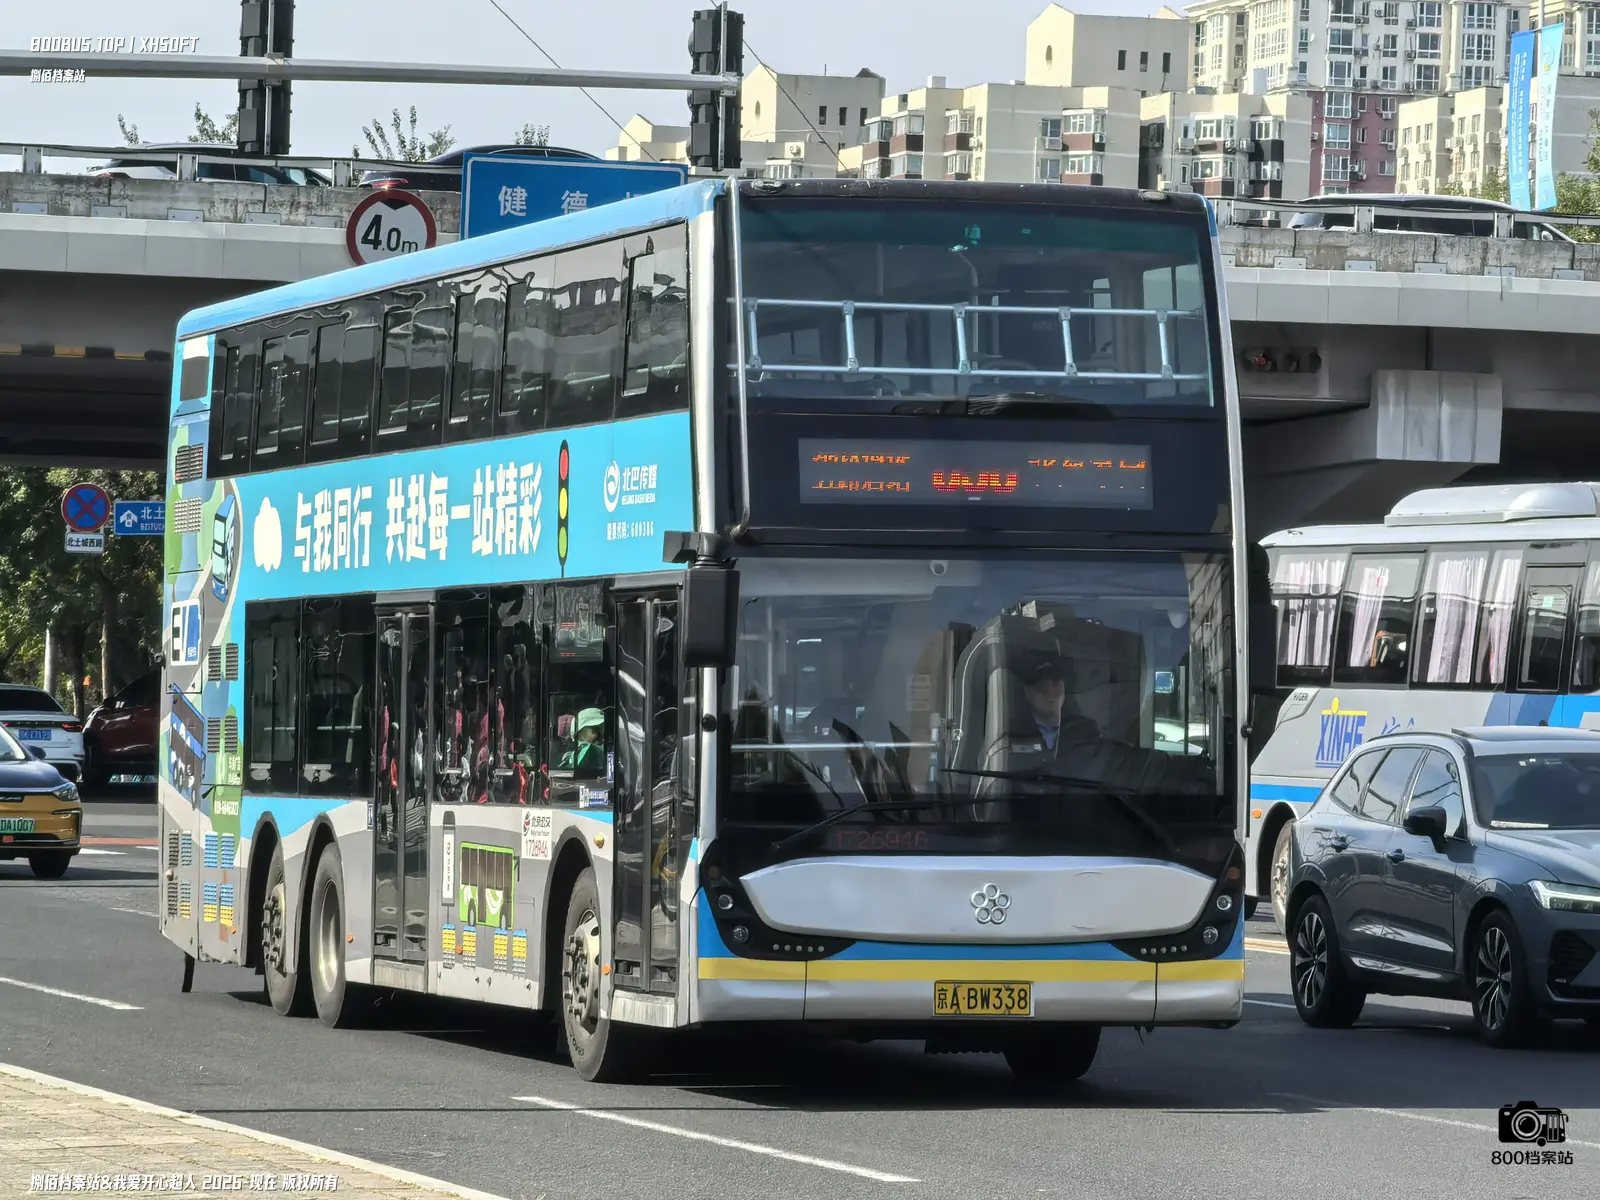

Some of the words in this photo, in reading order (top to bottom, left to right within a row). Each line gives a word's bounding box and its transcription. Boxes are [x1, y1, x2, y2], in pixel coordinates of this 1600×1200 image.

[361, 214, 419, 253] 4.0m
[294, 484, 373, 573] 与我同行
[385, 461, 542, 566] 共赴每一站精彩
[531, 816, 551, 828] 北京公交
